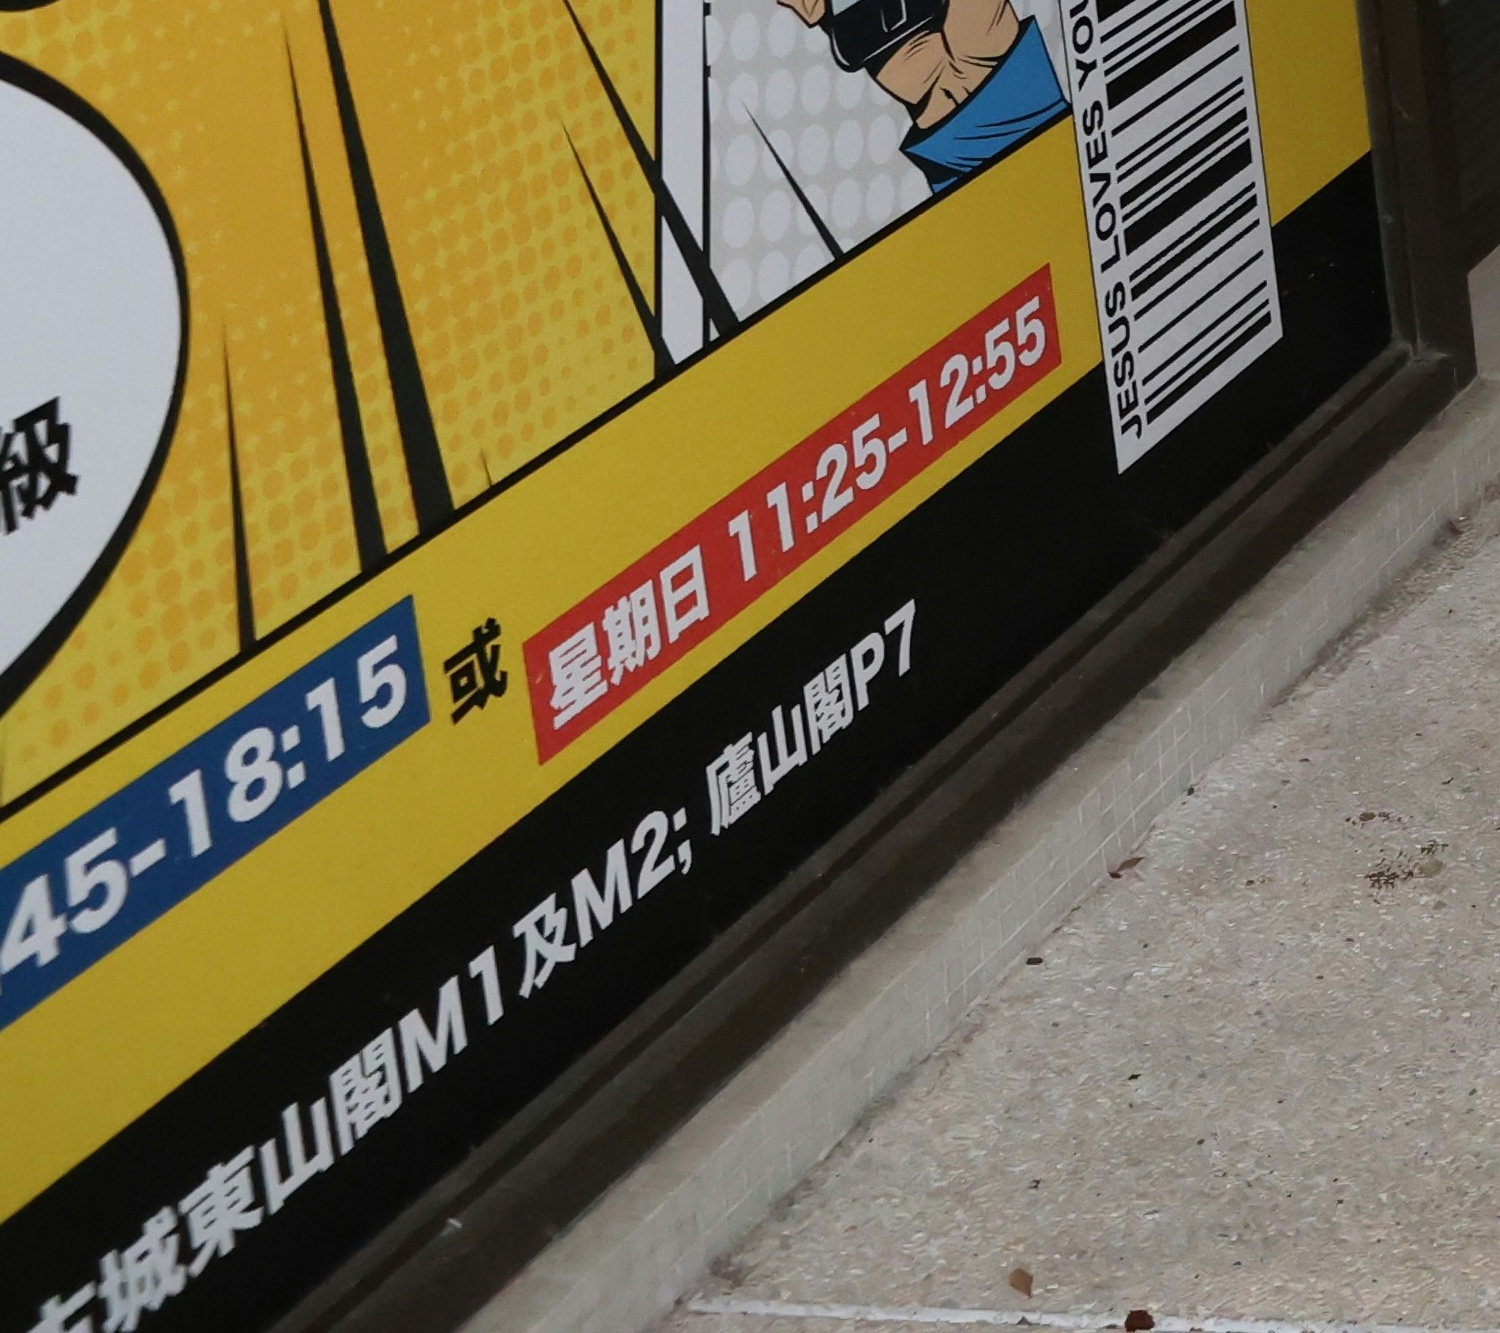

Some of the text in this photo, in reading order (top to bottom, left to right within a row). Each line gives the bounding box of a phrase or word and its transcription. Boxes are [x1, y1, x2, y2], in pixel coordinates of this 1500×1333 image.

[1082, 101, 1121, 274] LOVES
[1104, 280, 1143, 440] JESUS
[443, 617, 509, 725] 或
[548, 543, 711, 730] 星期日
[728, 295, 1048, 582] 11:25-12:55
